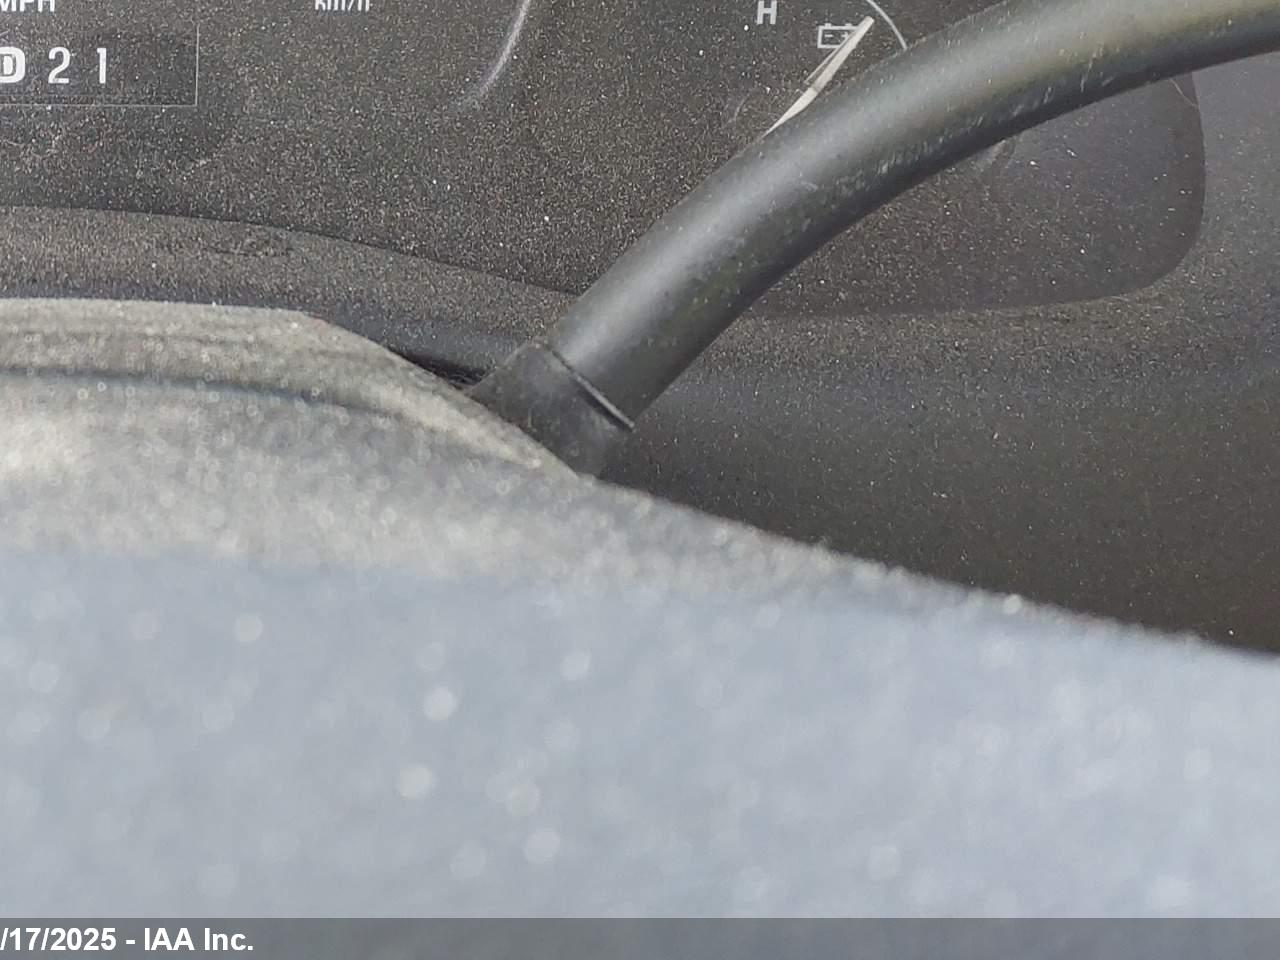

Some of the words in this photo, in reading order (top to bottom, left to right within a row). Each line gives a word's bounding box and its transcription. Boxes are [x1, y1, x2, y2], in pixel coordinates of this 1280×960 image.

[756, 0, 777, 24] H
[48, 47, 70, 83] 2
[97, 48, 106, 83] 1
